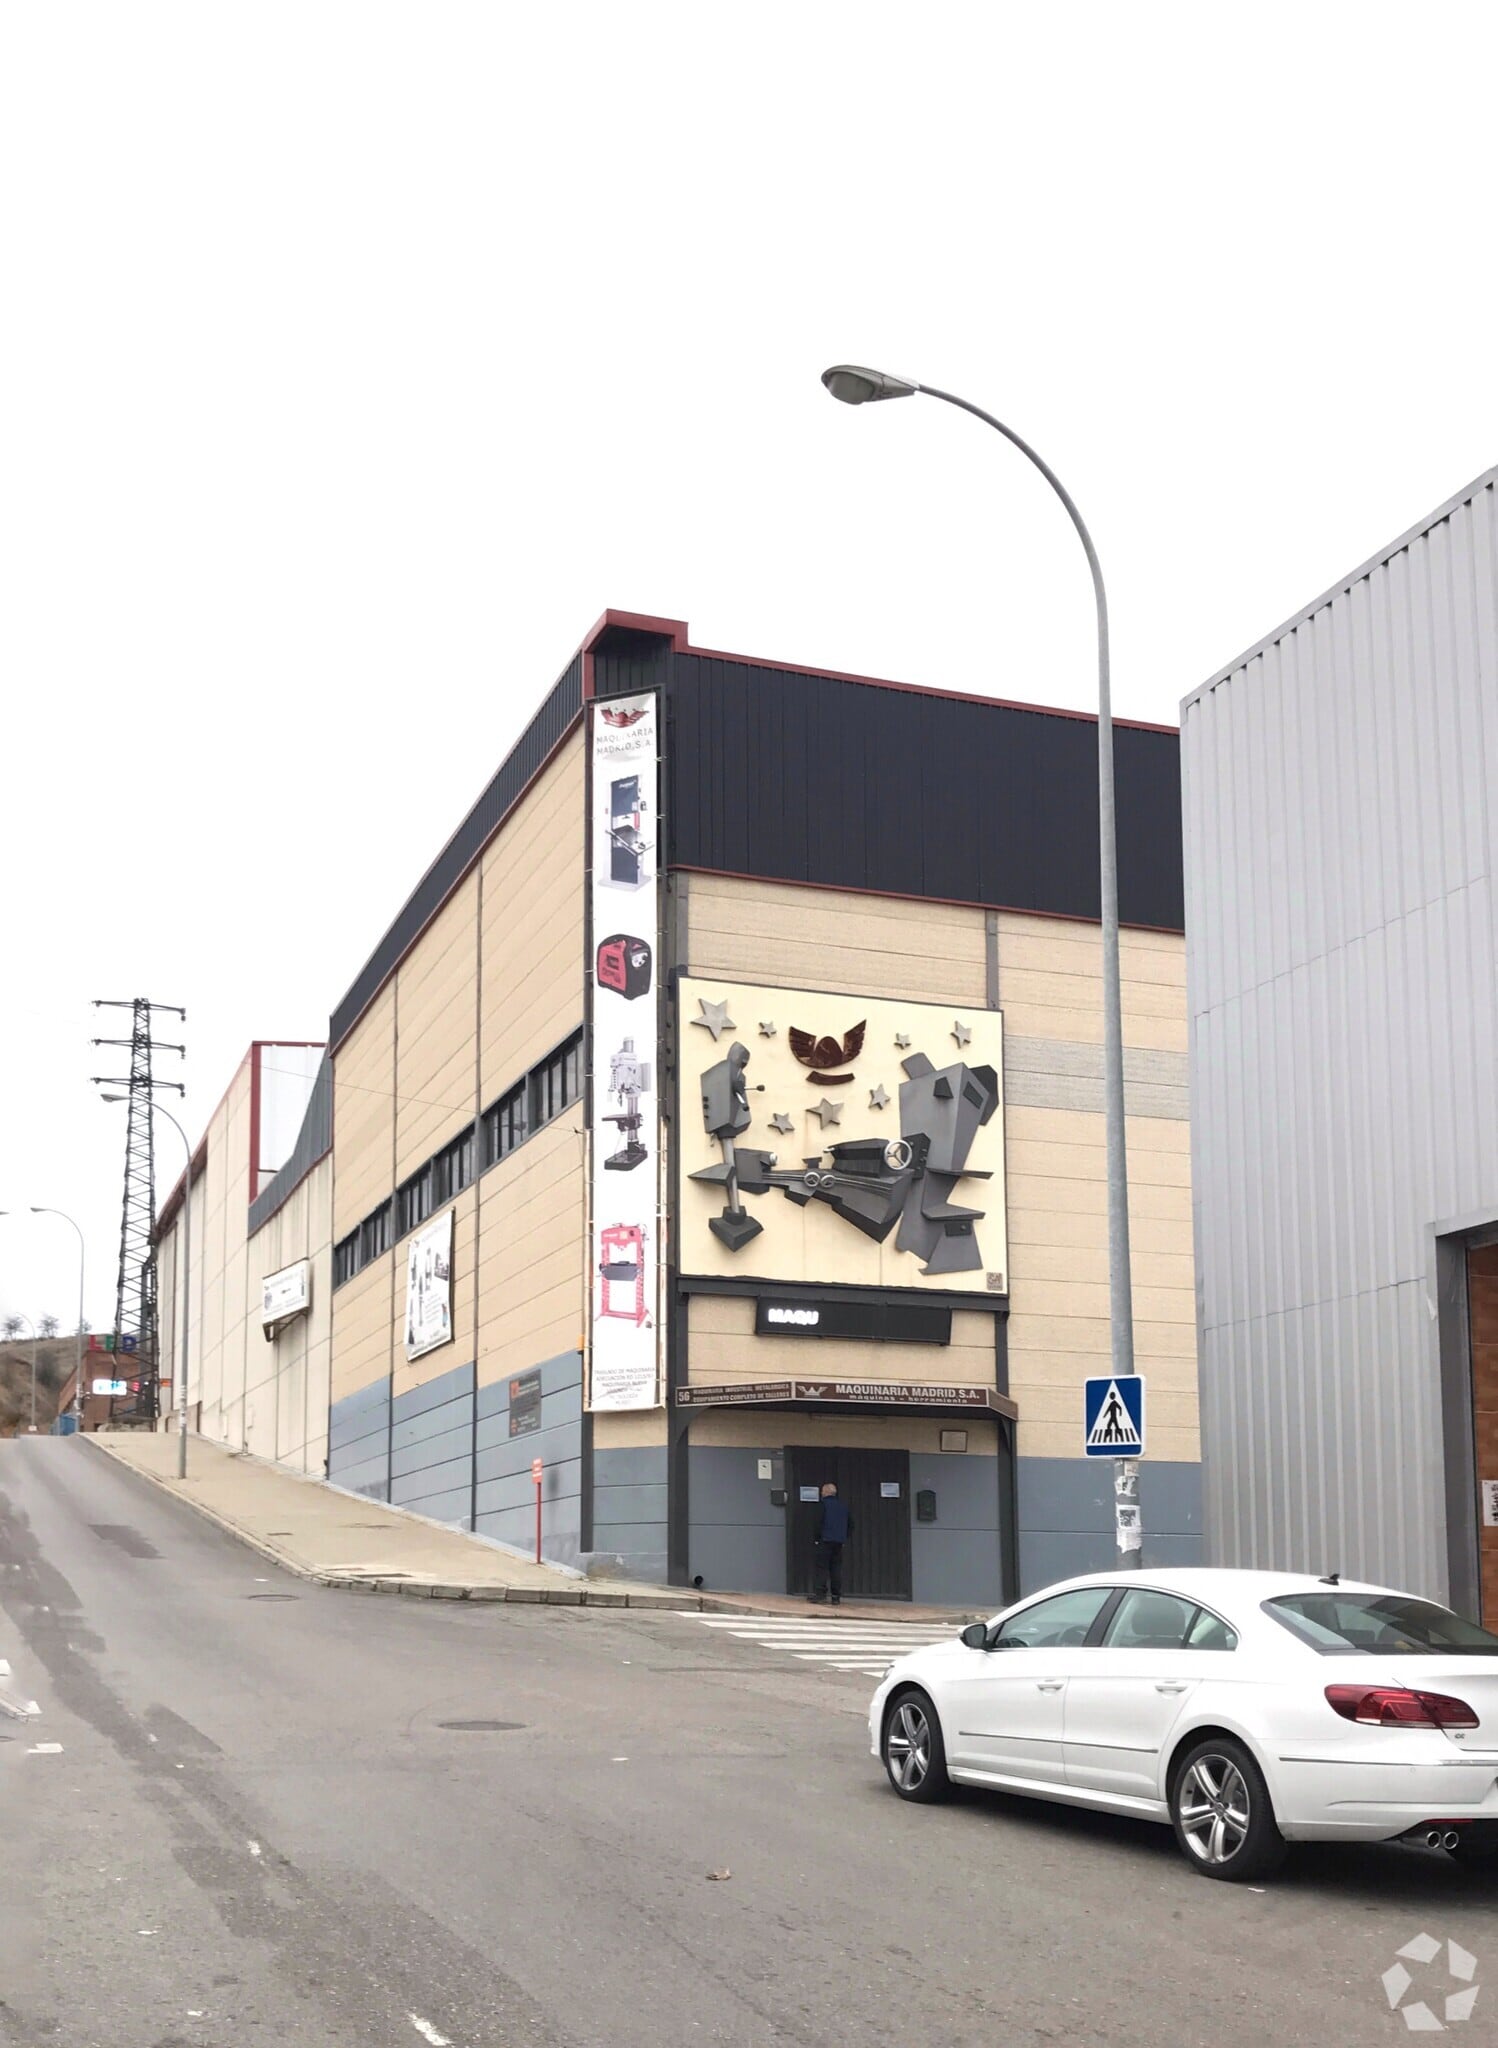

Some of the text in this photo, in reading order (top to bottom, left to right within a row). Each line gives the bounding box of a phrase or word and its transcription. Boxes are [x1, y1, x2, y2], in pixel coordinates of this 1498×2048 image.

[768, 1308, 819, 1326] MAQU
[835, 1384, 980, 1399] MAQUINARIA MADRID S.A.
